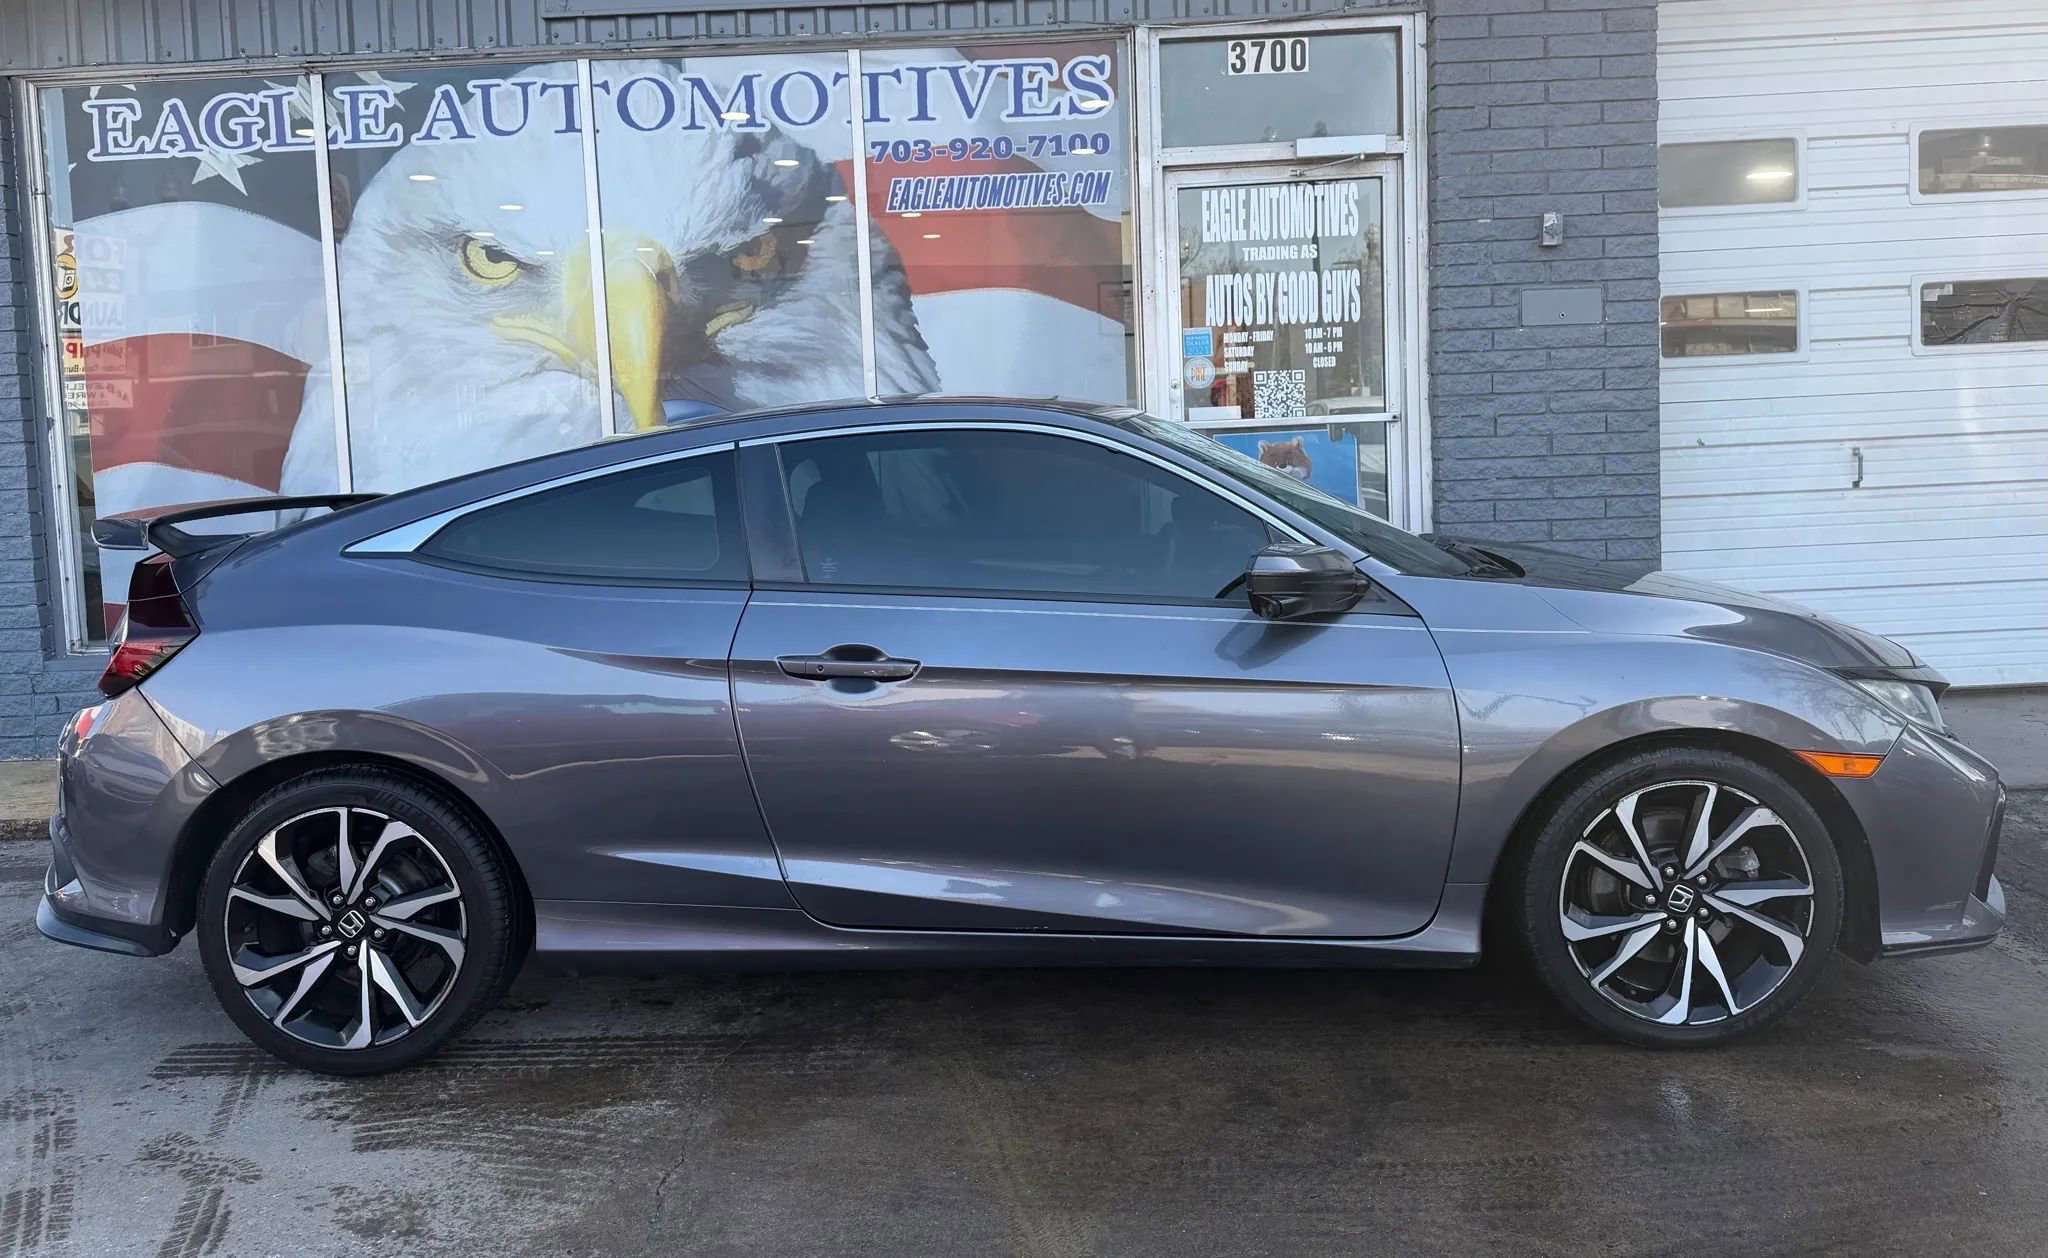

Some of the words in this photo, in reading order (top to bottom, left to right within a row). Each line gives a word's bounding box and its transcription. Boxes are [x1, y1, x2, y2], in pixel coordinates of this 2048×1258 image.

[1230, 38, 1306, 74] 3700
[84, 87, 401, 161] EAGLE
[417, 56, 1112, 142] AUTOMOTIVES
[870, 133, 1111, 163] 703-920-7100
[887, 171, 1112, 212] EAGLEAUTOMOTIVES.COM
[1202, 188, 1247, 243] EAGLE
[1249, 182, 1359, 241] AUTOMOTIVES
[1242, 246, 1298, 262] TRADING
[1300, 244, 1318, 259] AS
[1206, 272, 1253, 327] AUTOS
[1255, 272, 1276, 325] BY
[1278, 270, 1319, 325] GOOD
[1321, 268, 1361, 323] GUYS
[1223, 332, 1248, 344] MONDAY
[1252, 330, 1274, 342] FRIDAY
[1304, 327, 1312, 340] 10
[1312, 327, 1323, 339] AM
[1326, 327, 1331, 338] 7
[1332, 326, 1343, 338] PM
[1223, 345, 1254, 358] SATURDAY
[1304, 342, 1312, 354] 10
[1313, 342, 1323, 354] AM
[1332, 341, 1343, 352] PM
[1224, 360, 1248, 373] SUNDAY
[1312, 355, 1336, 368] CLOSED
